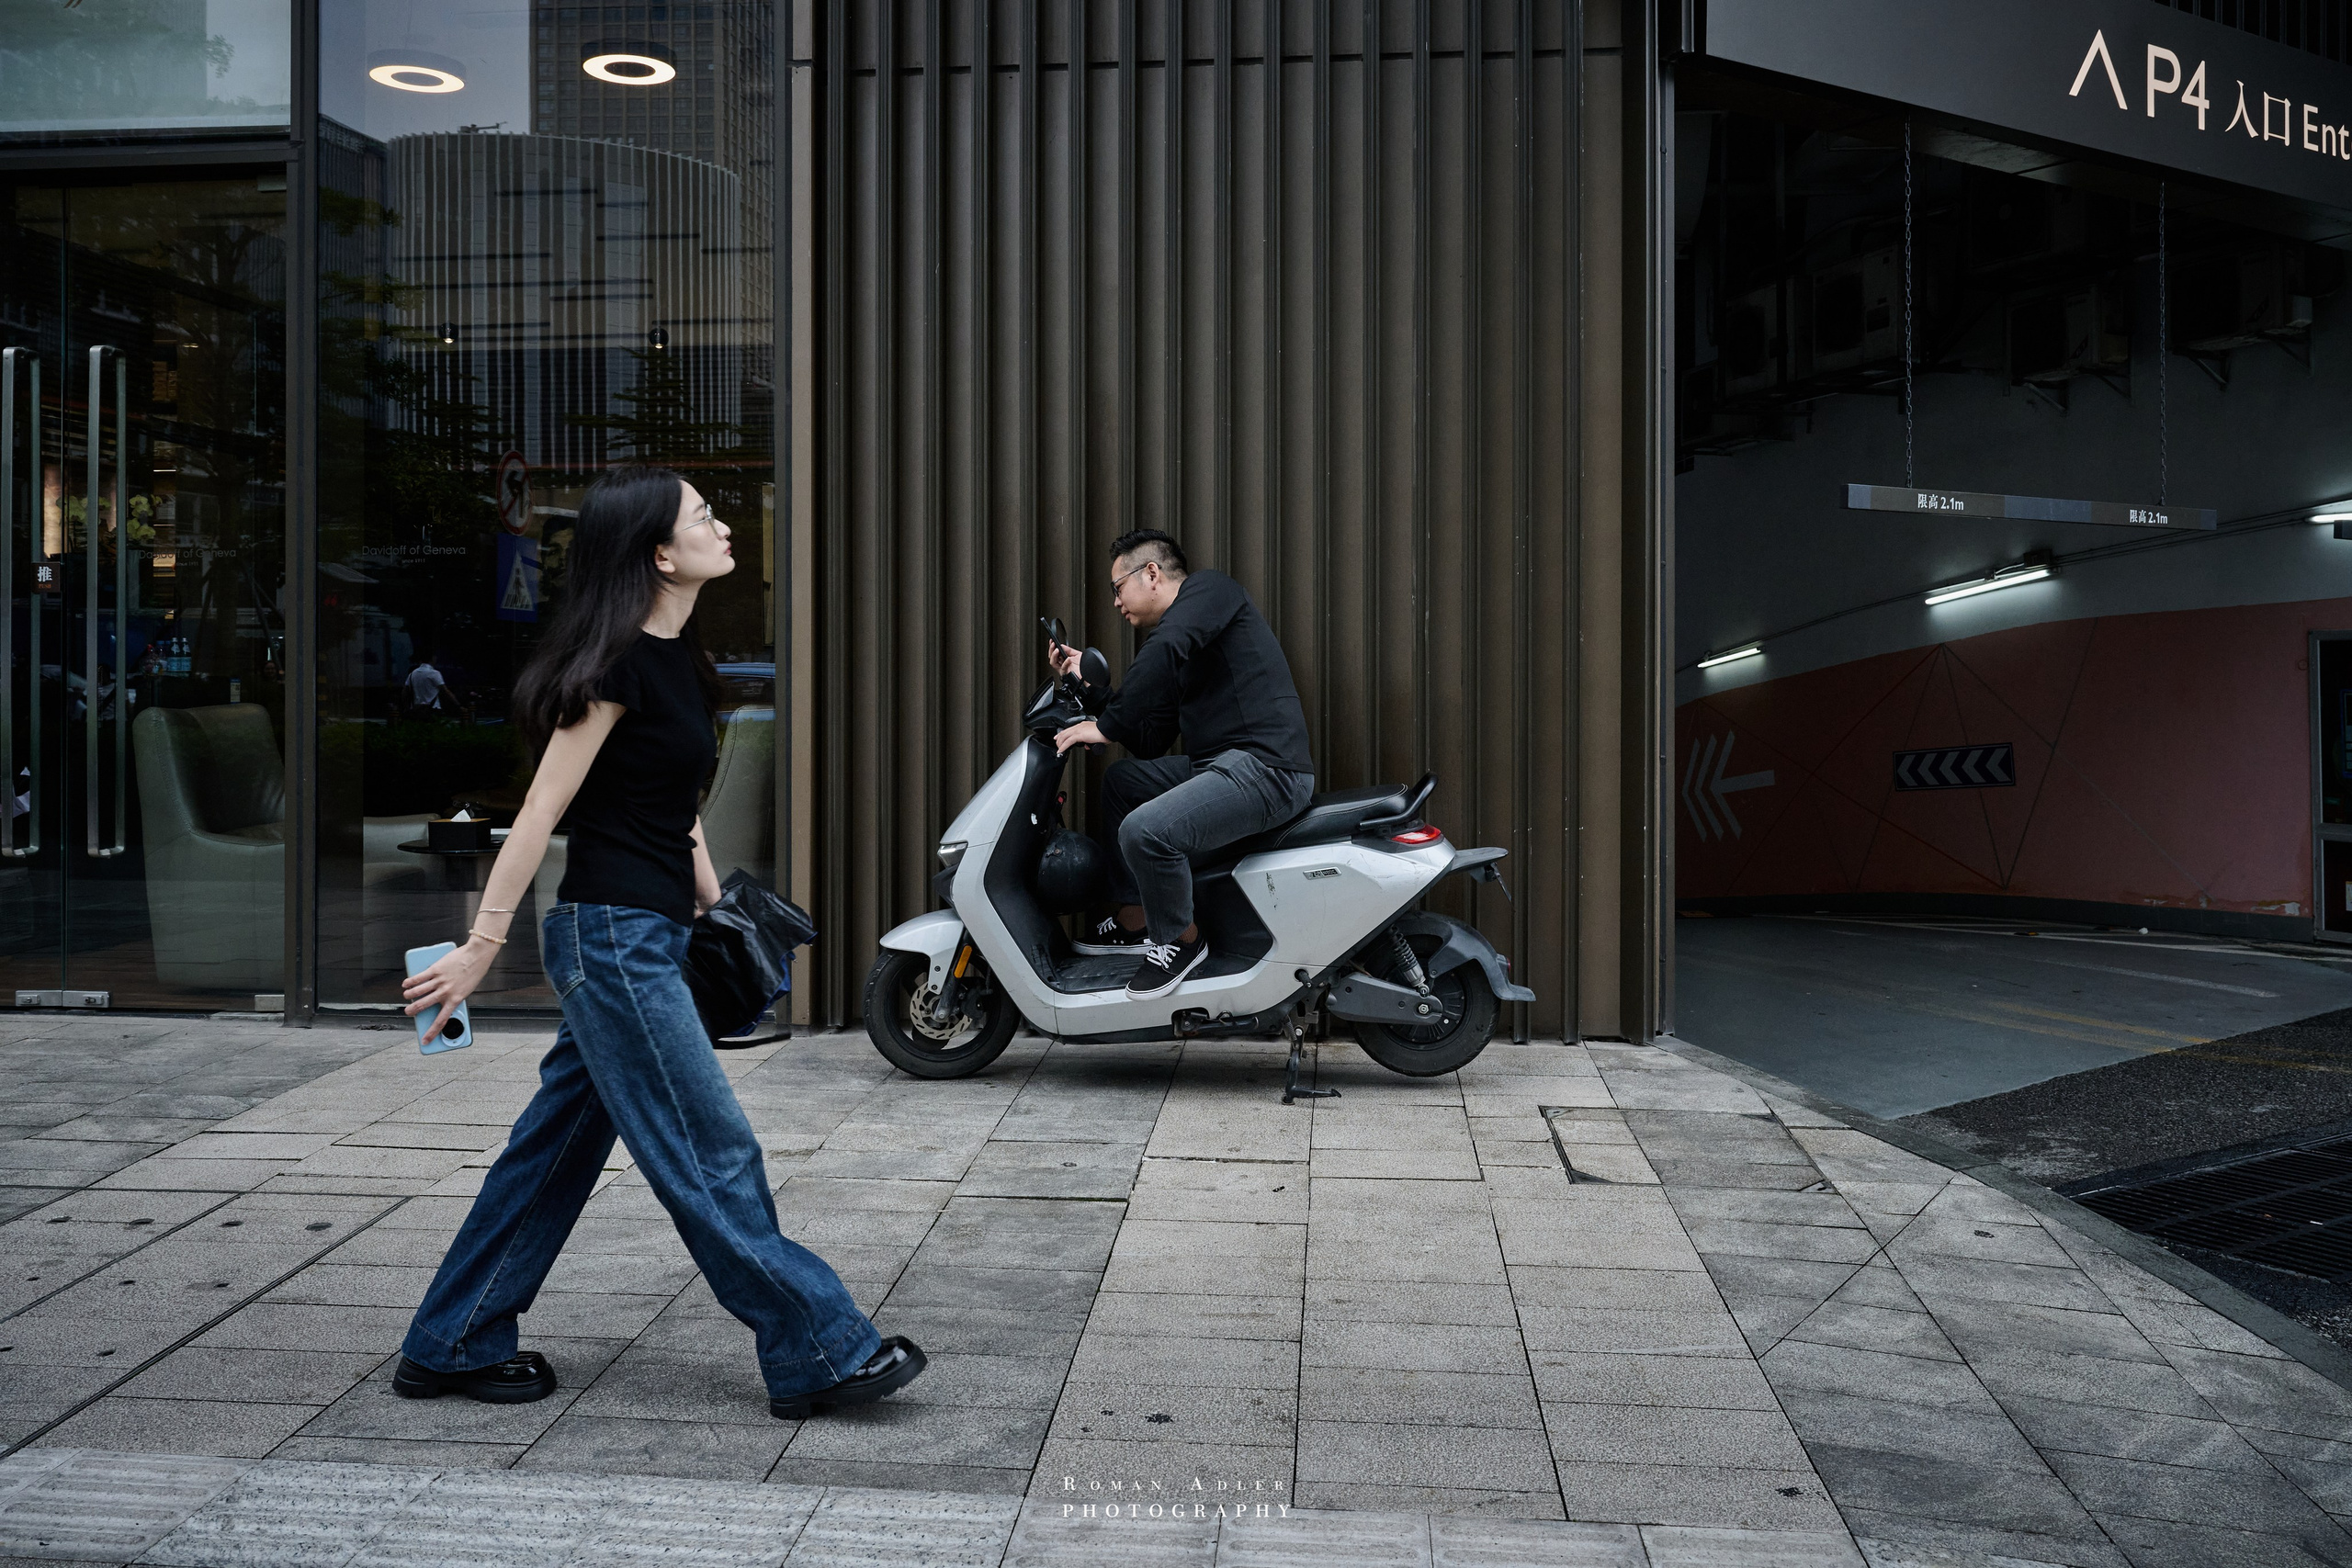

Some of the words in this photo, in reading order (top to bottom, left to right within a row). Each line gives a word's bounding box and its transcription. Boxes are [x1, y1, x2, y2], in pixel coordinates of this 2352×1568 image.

[2147, 43, 2210, 130] P4
[2224, 80, 2291, 147] 入口
[2303, 103, 2352, 161] Ent
[1917, 493, 1939, 510] 限高
[1940, 496, 1964, 511] 2.1m
[2130, 509, 2146, 524] 限高
[2148, 512, 2168, 525] 2.1m
[184, 548, 194, 558] of
[362, 545, 407, 556] Davidoff
[409, 545, 421, 556] of
[423, 545, 466, 556] Geneva
[38, 566, 53, 581] 推
